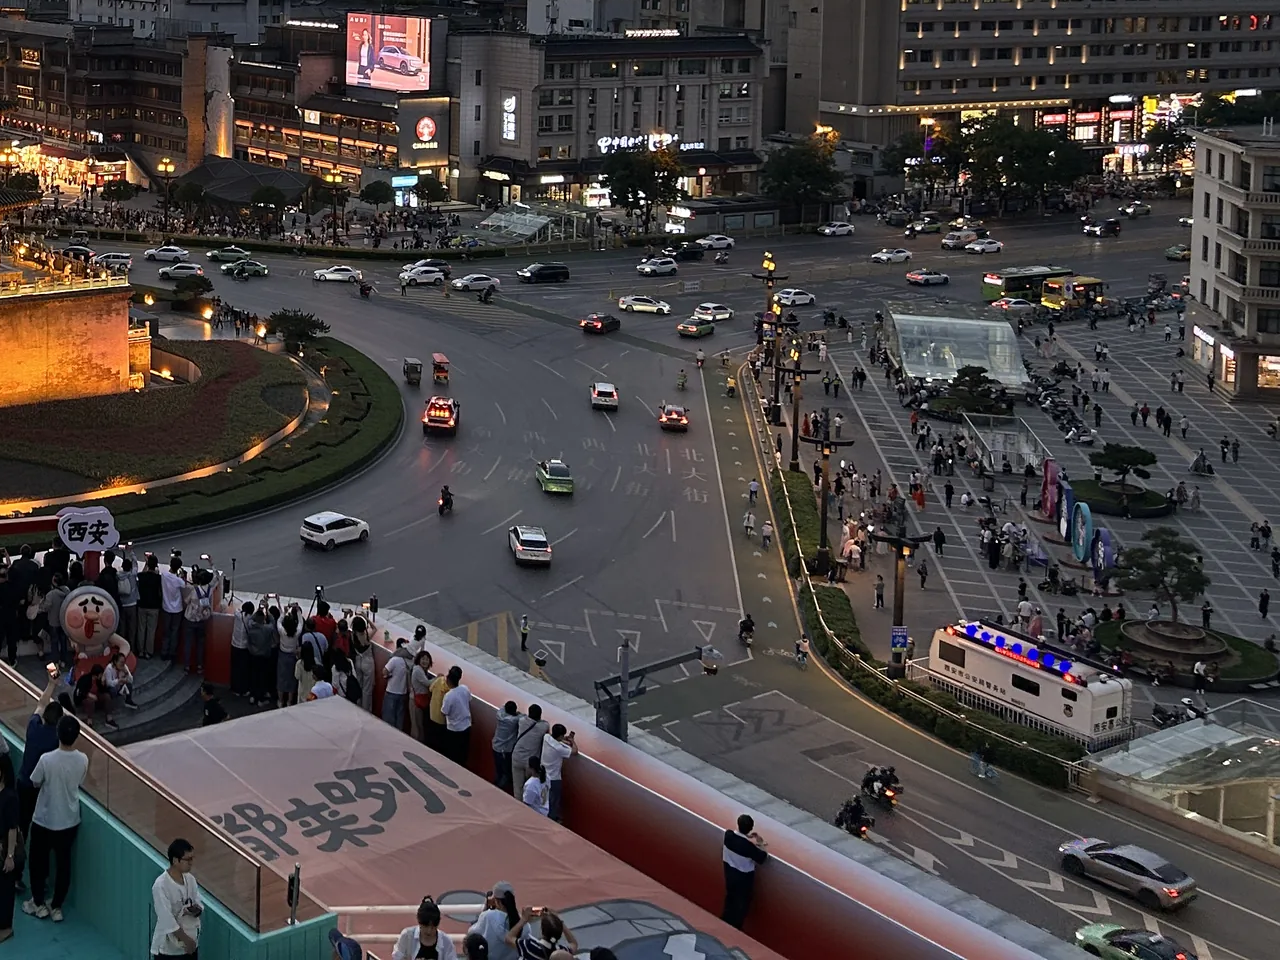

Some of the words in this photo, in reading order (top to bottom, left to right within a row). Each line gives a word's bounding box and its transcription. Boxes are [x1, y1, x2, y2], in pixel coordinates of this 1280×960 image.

[679, 447, 710, 505] 北大街
[66, 520, 109, 546] 西安
